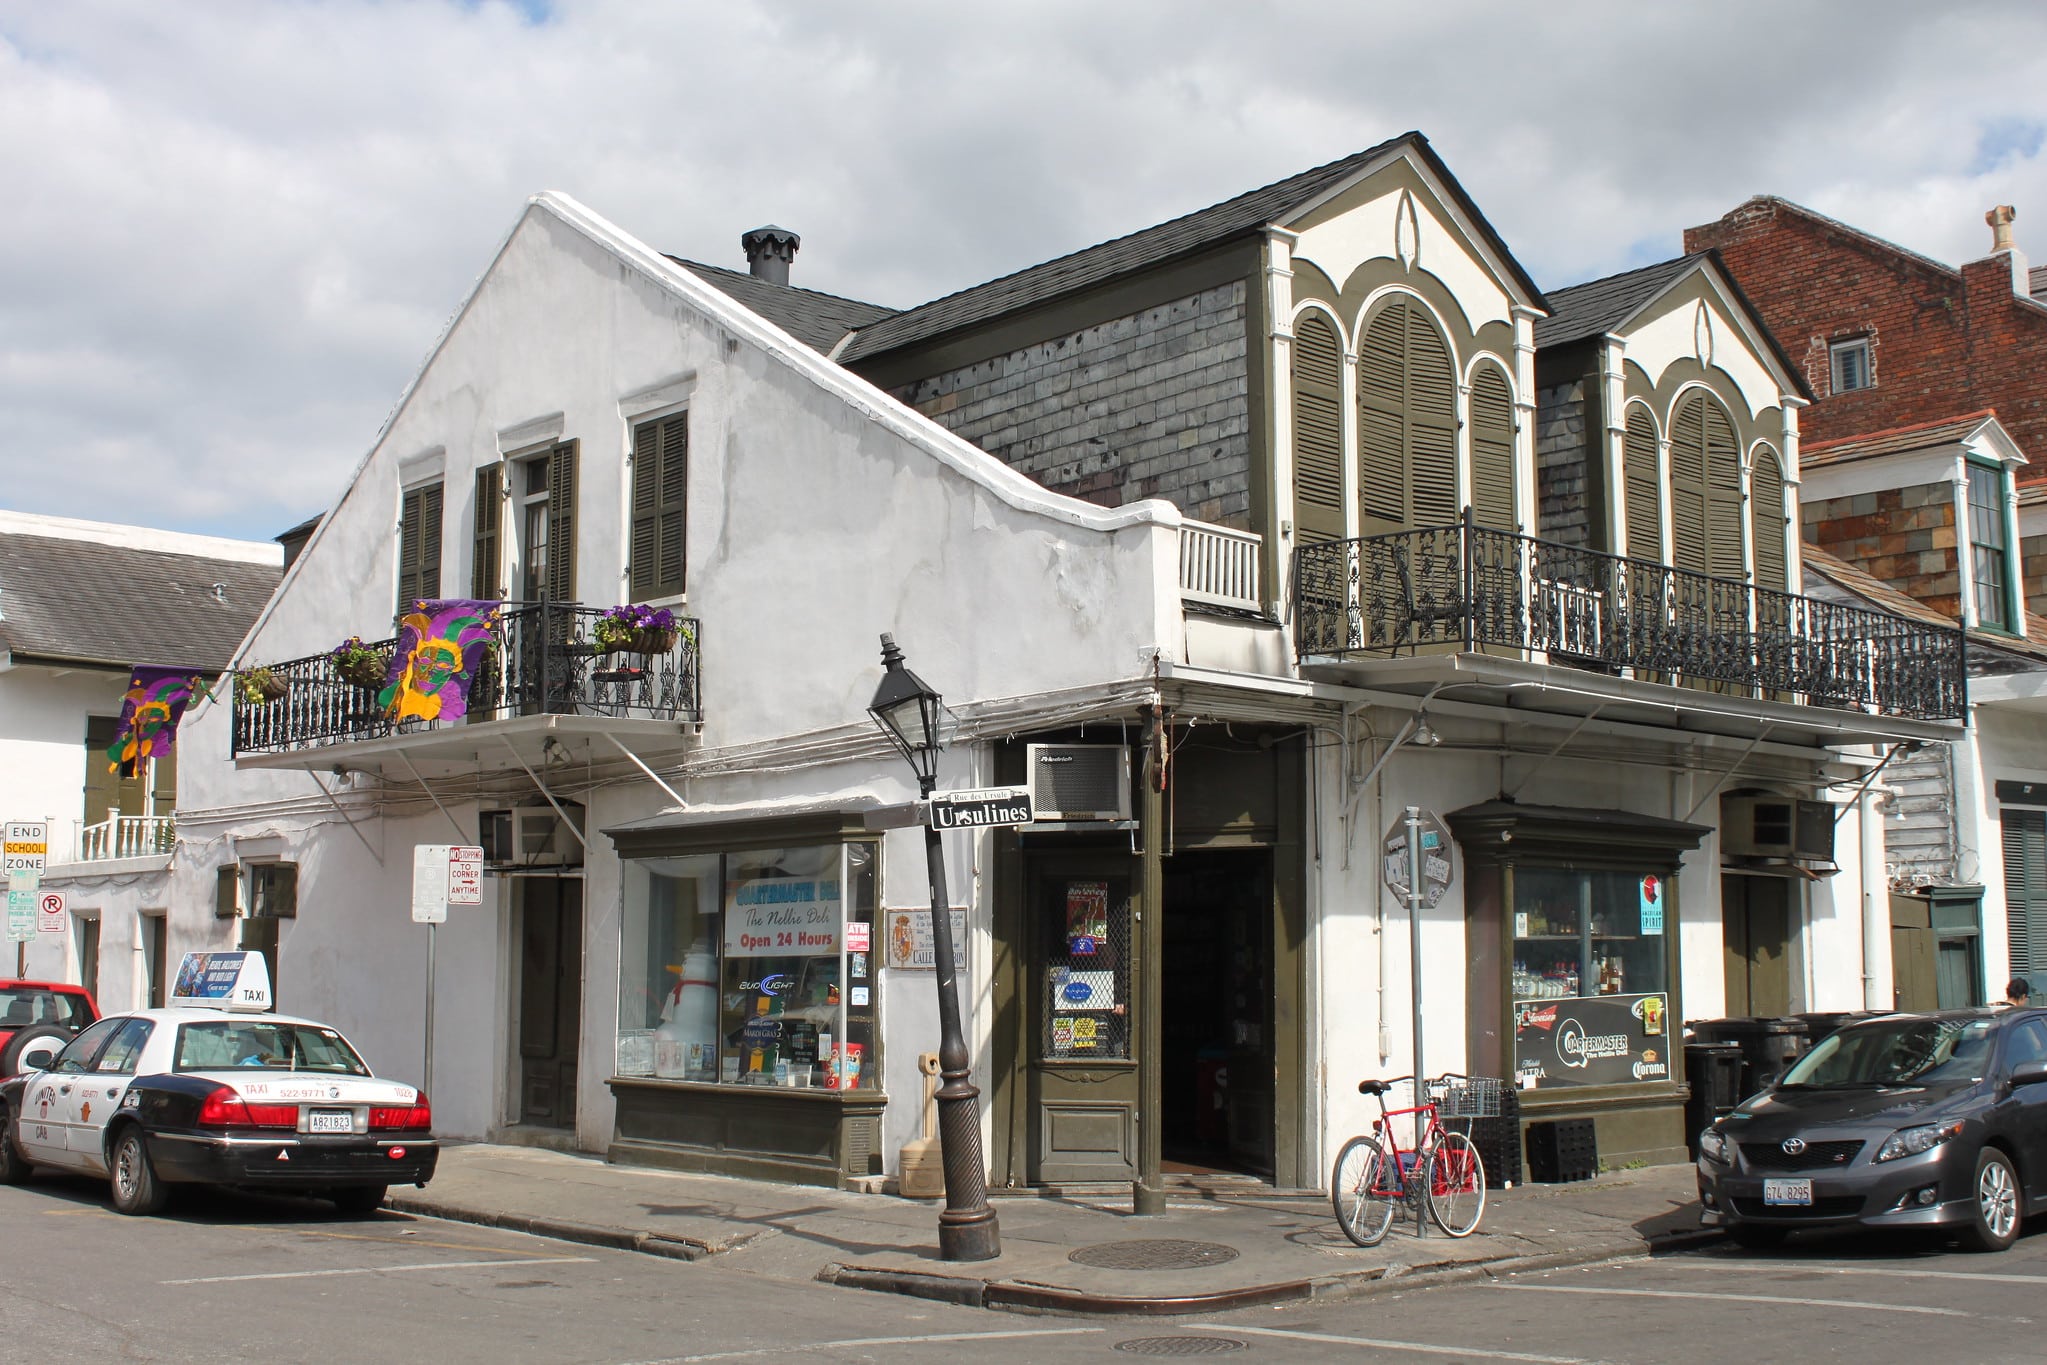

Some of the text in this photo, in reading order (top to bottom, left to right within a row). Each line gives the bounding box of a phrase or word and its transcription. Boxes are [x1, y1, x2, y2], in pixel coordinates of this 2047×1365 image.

[936, 803, 1028, 827] Ursulines
[13, 827, 41, 837] END
[6, 843, 44, 854] SCHOOL
[450, 849, 482, 860] NO STOPPING
[6, 859, 43, 868] ZONE
[452, 870, 479, 878] CORNER
[451, 886, 479, 895] ANYTIME
[746, 905, 831, 927] The Nellie Deli
[1642, 917, 1662, 927] SPIRIT
[848, 924, 868, 934] ATM
[740, 933, 771, 951] Open
[777, 932, 793, 947] 24
[798, 931, 833, 946] Hours
[913, 951, 933, 964] CALLE
[739, 981, 795, 990] BUD LIGHT
[244, 990, 265, 1001] TAXI
[743, 1028, 762, 1037] MARDI
[1556, 1018, 1628, 1068] QUARTERMASTER
[1633, 1062, 1666, 1080] Corona
[244, 1084, 268, 1094] TAXI
[280, 1090, 325, 1098] 522-9771
[34, 1086, 56, 1107] UNITED
[313, 1116, 350, 1128] A821823
[35, 1125, 47, 1140] CAB
[1767, 1186, 1809, 1200] G74 8295
